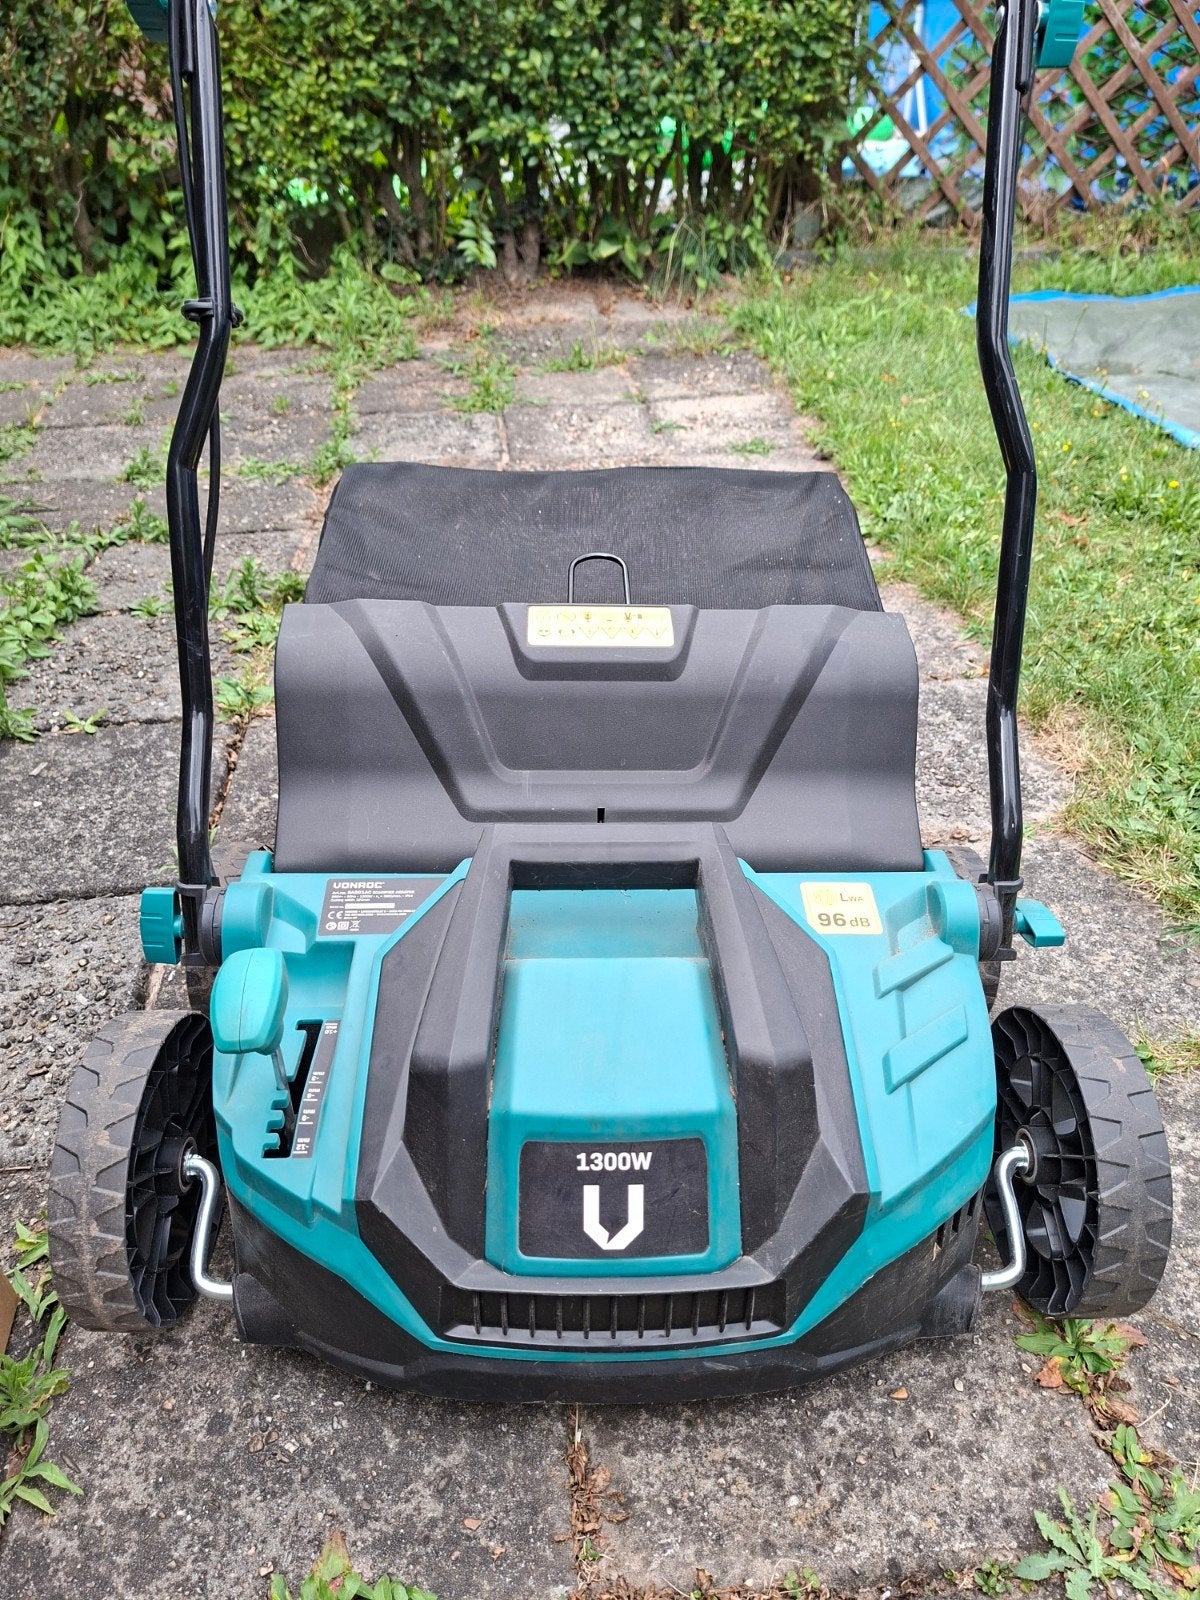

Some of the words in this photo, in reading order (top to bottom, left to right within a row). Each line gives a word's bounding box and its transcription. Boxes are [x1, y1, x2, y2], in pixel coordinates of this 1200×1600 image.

[817, 913, 847, 927] 96
[849, 917, 871, 927] dB
[576, 1151, 653, 1171] 1300W
